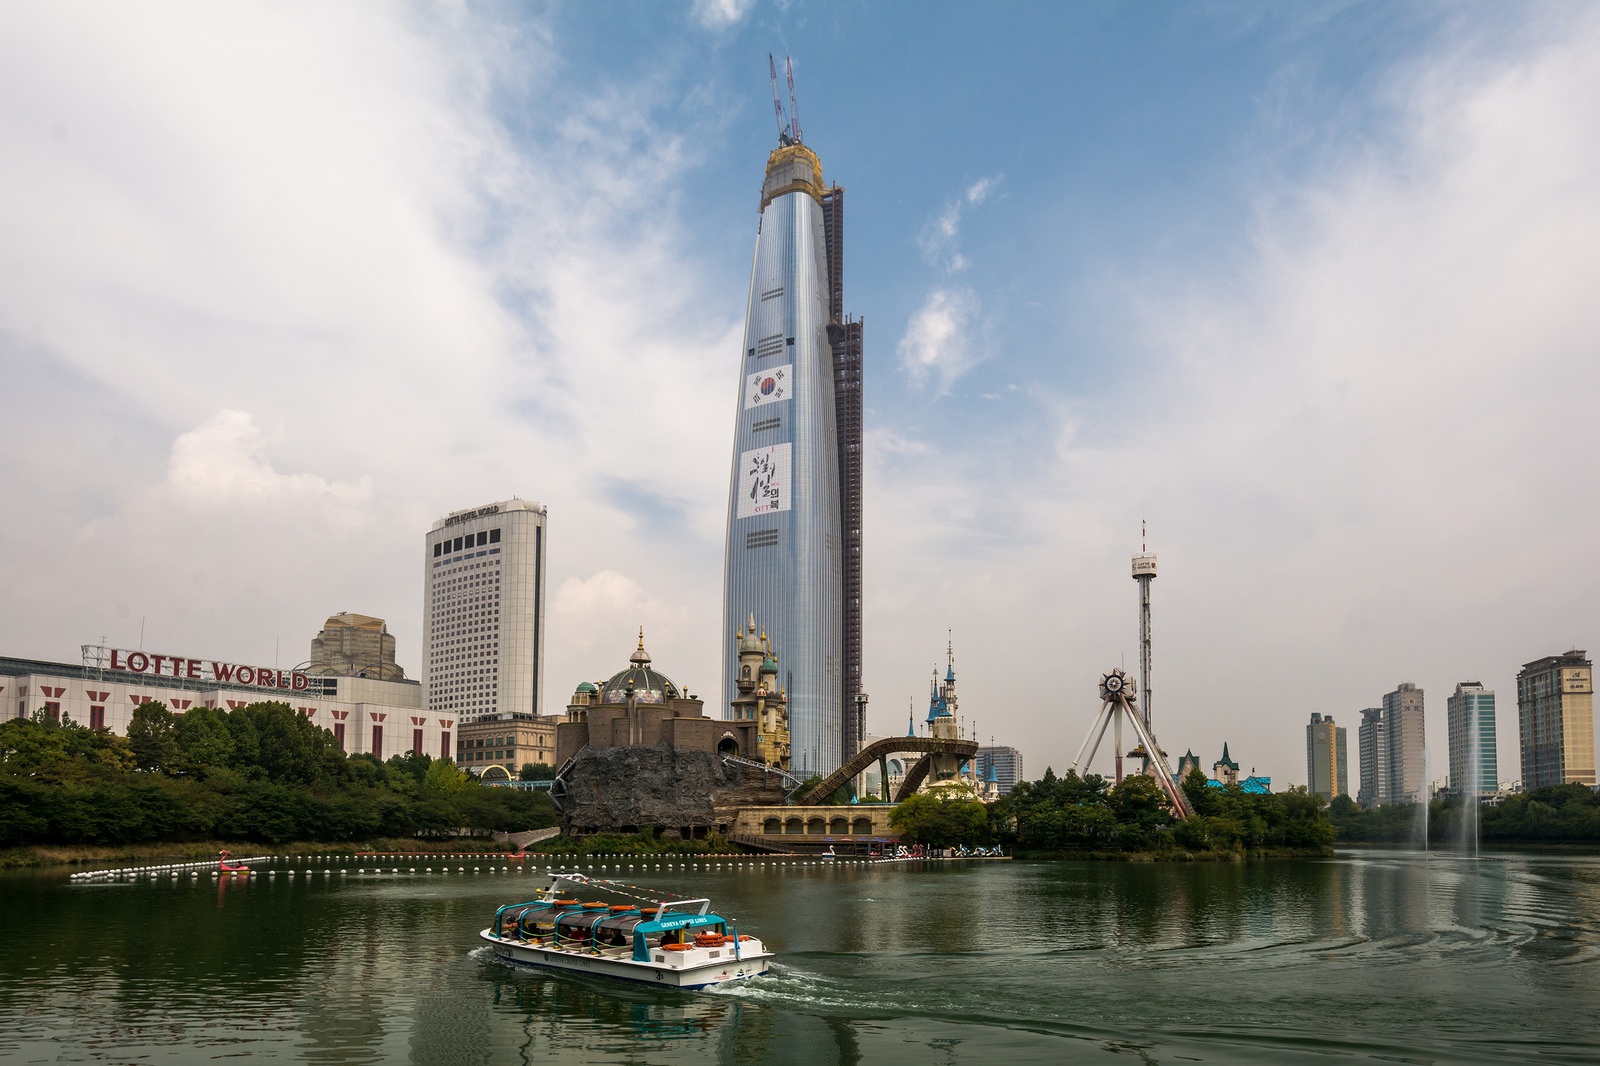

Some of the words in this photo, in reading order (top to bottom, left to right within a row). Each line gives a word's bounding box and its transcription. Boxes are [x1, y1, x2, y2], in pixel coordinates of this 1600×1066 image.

[445, 515, 460, 526] LOTTE
[478, 506, 499, 516] WORLD
[110, 649, 201, 679] LOTTE
[212, 661, 309, 691] WORLD
